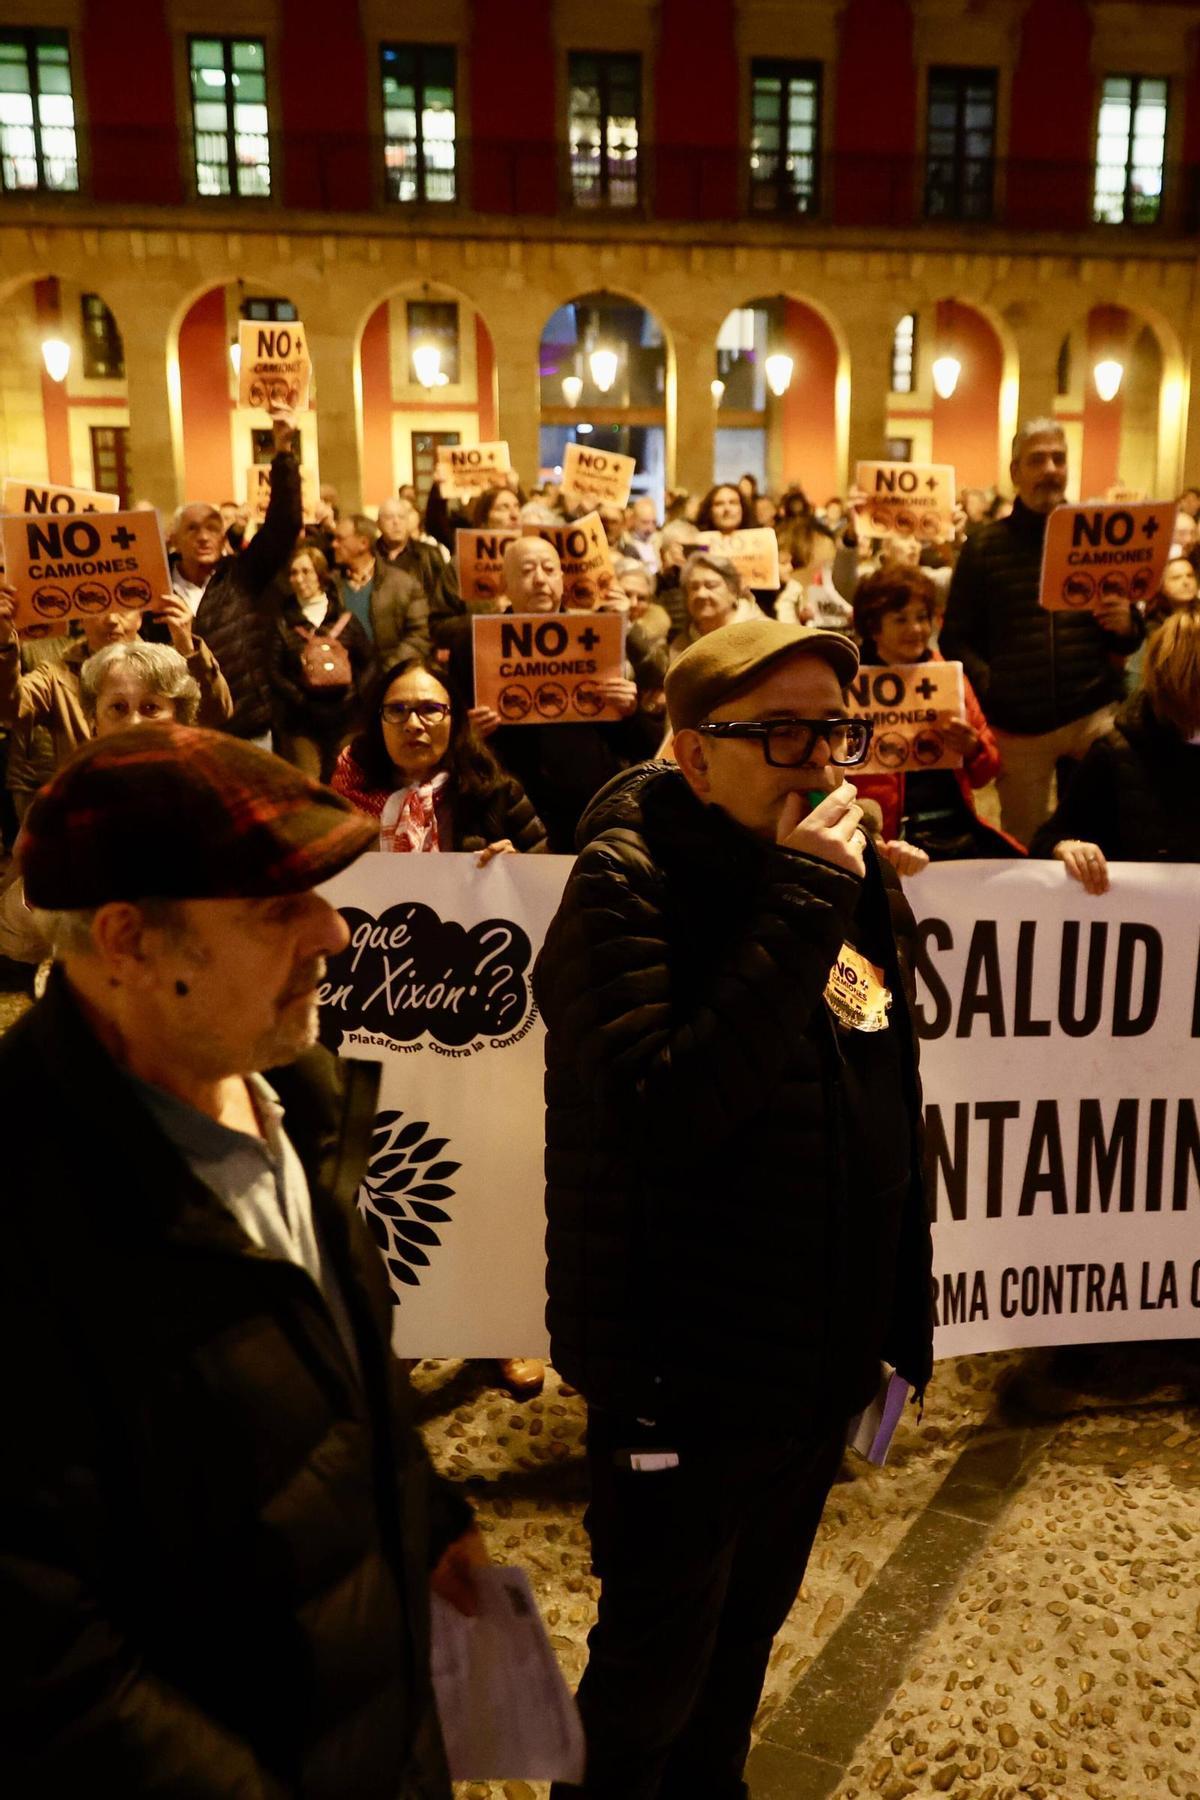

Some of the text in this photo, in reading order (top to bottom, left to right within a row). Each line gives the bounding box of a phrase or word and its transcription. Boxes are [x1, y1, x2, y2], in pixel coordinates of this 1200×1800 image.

[258, 330, 291, 358] NO
[451, 451, 482, 466] NO
[579, 452, 607, 471] NO
[876, 469, 918, 493] NO
[24, 488, 75, 514] NO
[26, 521, 101, 560] NO
[1072, 511, 1134, 547] NO
[29, 557, 138, 580] CAMIONES
[1067, 547, 1153, 565] CAMIONES
[502, 621, 568, 658] NO
[500, 660, 596, 678] CAMIONES
[841, 673, 905, 708] NO
[854, 708, 937, 726] AMIONES
[351, 908, 416, 973] qué
[836, 961, 858, 985] NO
[914, 918, 1164, 1040] SALUD
[315, 982, 354, 1011] en
[349, 1033, 423, 1054] Plataforma
[428, 1041, 472, 1058] contra
[471, 1041, 485, 1053] la
[1000, 1262, 1128, 1319] CONTRA
[1140, 1260, 1179, 1311] LA
